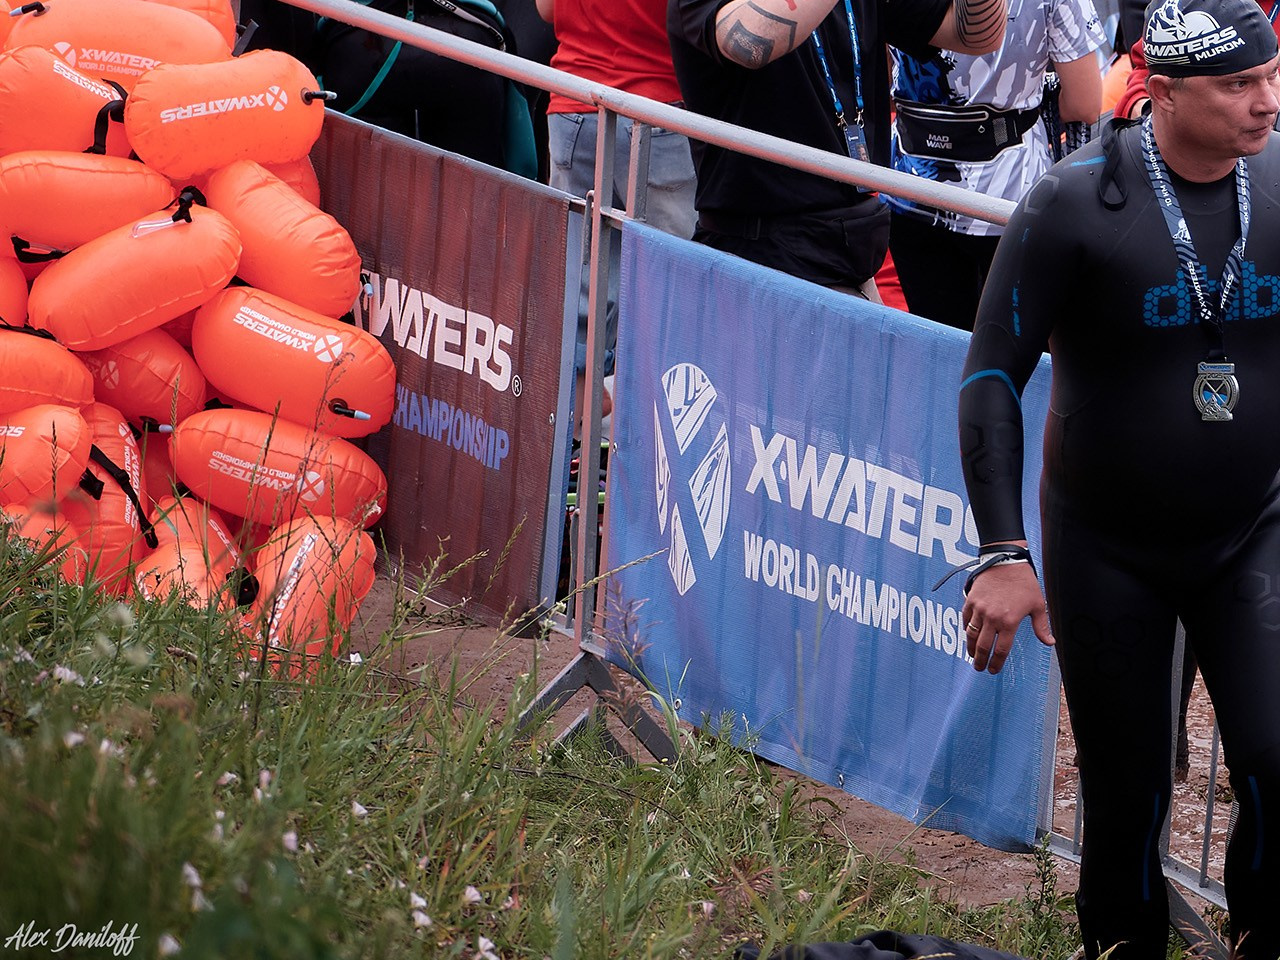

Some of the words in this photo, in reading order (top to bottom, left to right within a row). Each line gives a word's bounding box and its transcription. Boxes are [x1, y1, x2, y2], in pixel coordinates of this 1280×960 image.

[1194, 38, 1246, 61] MUROM
[926, 140, 952, 150] WAVE
[928, 133, 950, 143] MAD
[291, 324, 317, 341] WORLD
[393, 383, 511, 471] HAMPIONSHIP
[744, 529, 819, 603] WORLD
